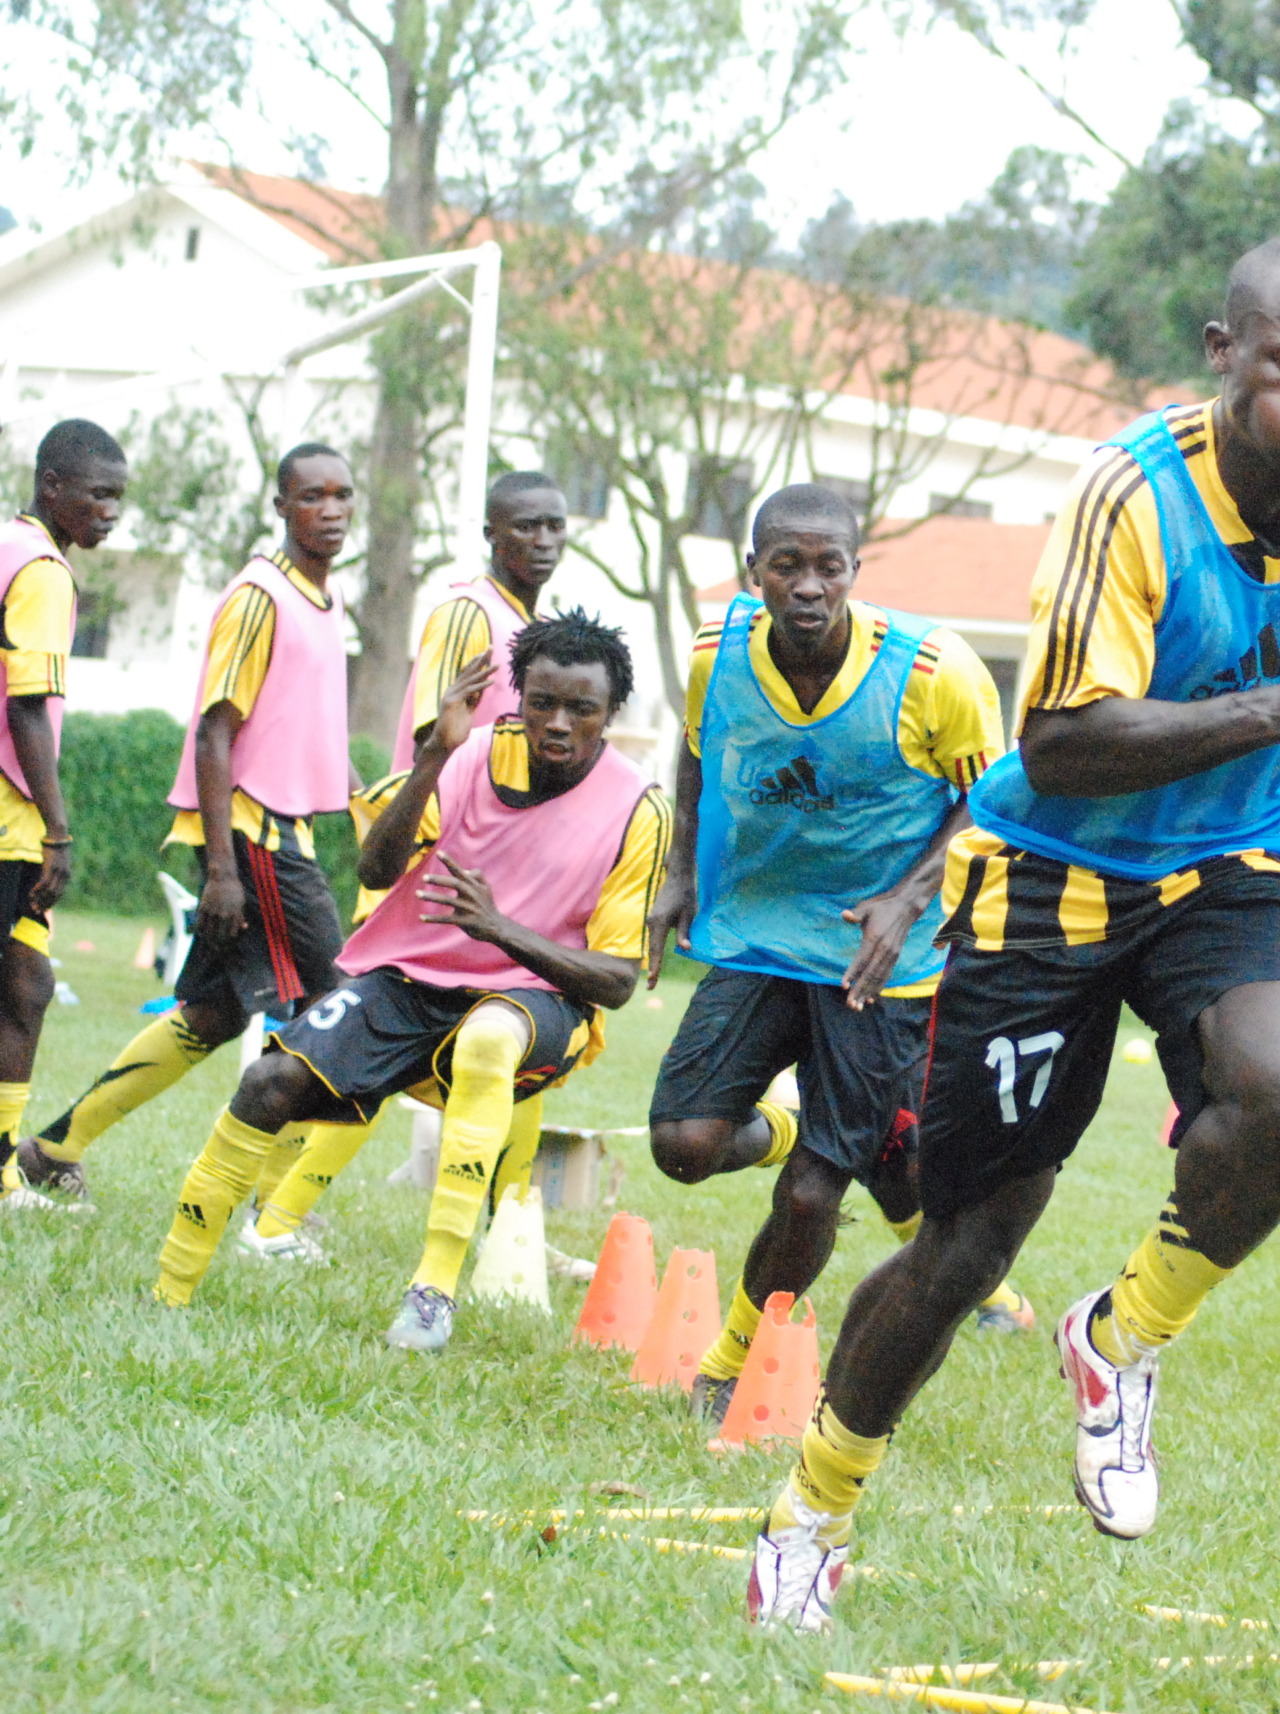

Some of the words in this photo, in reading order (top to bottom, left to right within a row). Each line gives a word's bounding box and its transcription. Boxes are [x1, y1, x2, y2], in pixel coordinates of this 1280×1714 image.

[749, 787, 835, 813] adidas
[308, 989, 362, 1030] 5
[984, 1031, 1065, 1123] 17
